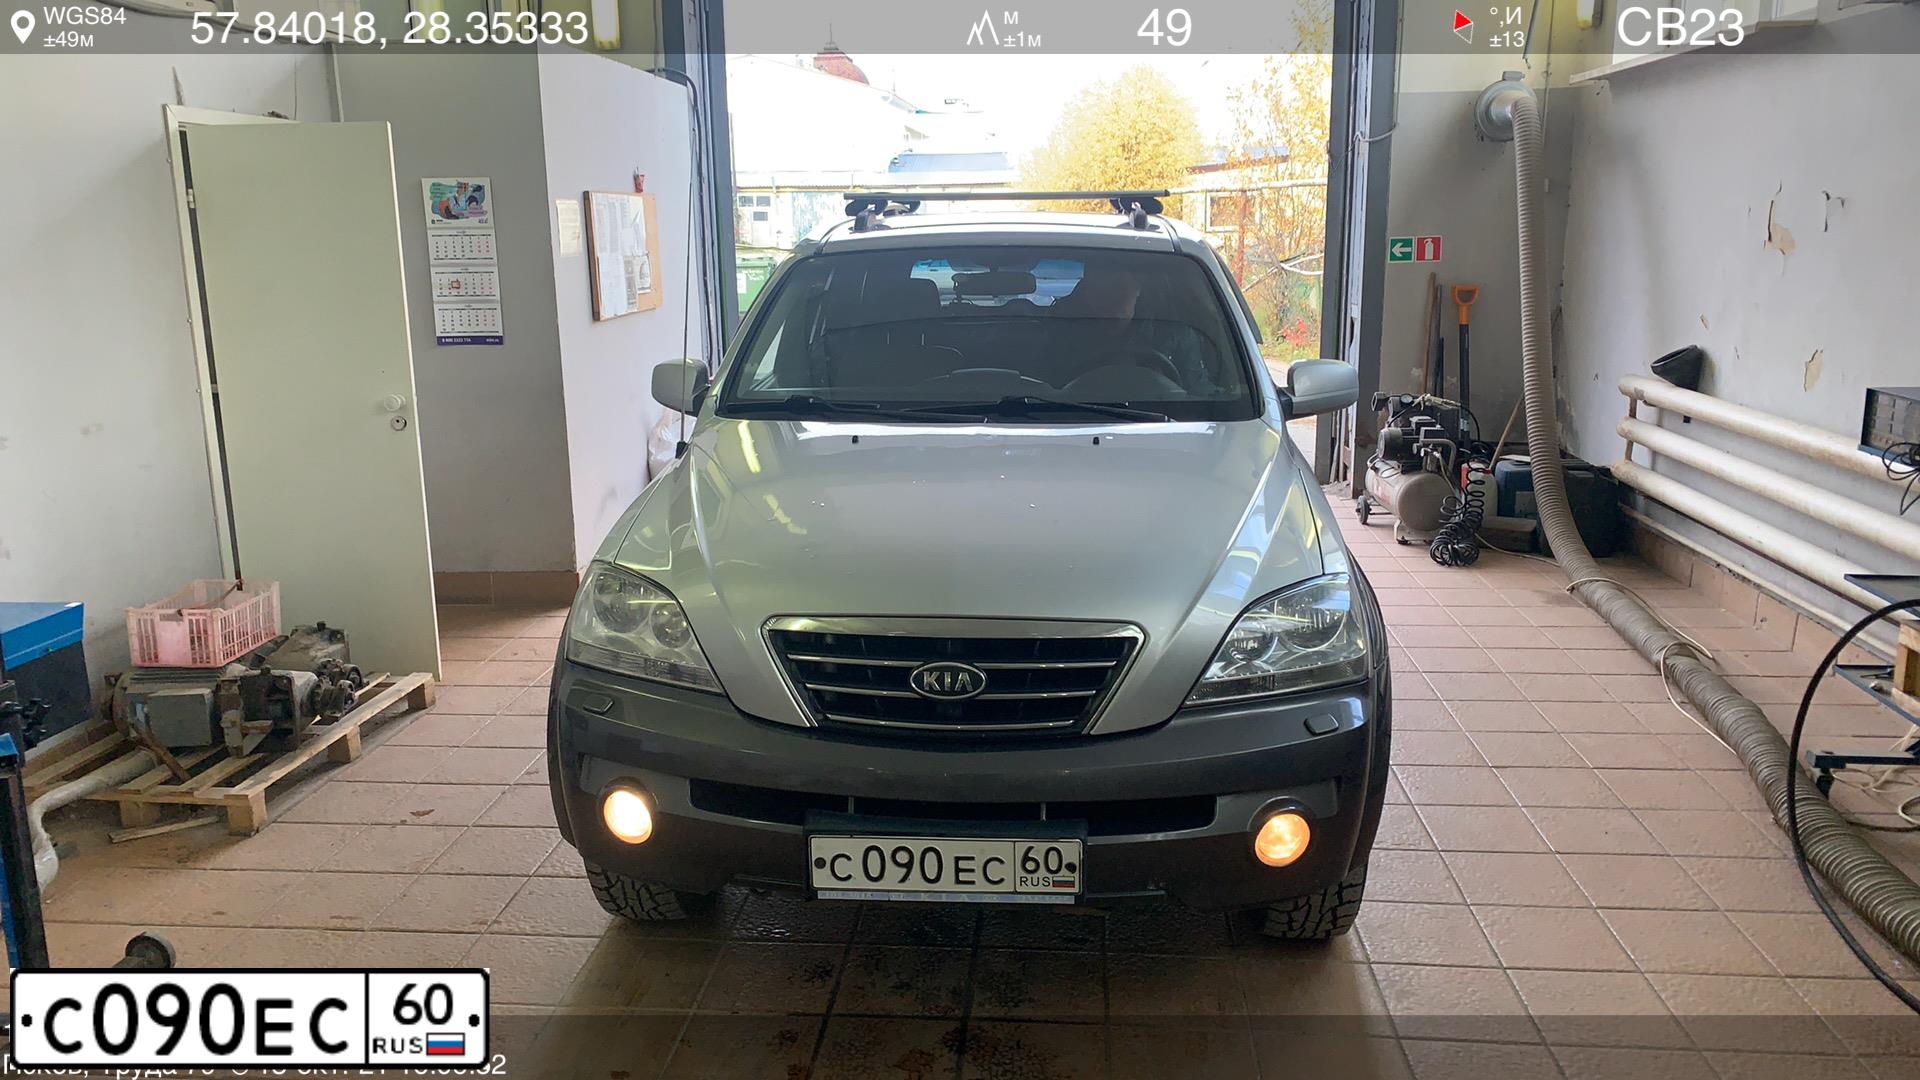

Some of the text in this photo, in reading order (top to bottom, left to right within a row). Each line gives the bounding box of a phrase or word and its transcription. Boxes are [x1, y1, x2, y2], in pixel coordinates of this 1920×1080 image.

[923, 671, 974, 691] KIA
[1020, 846, 1063, 874] 60
[1019, 876, 1051, 887] RUS
